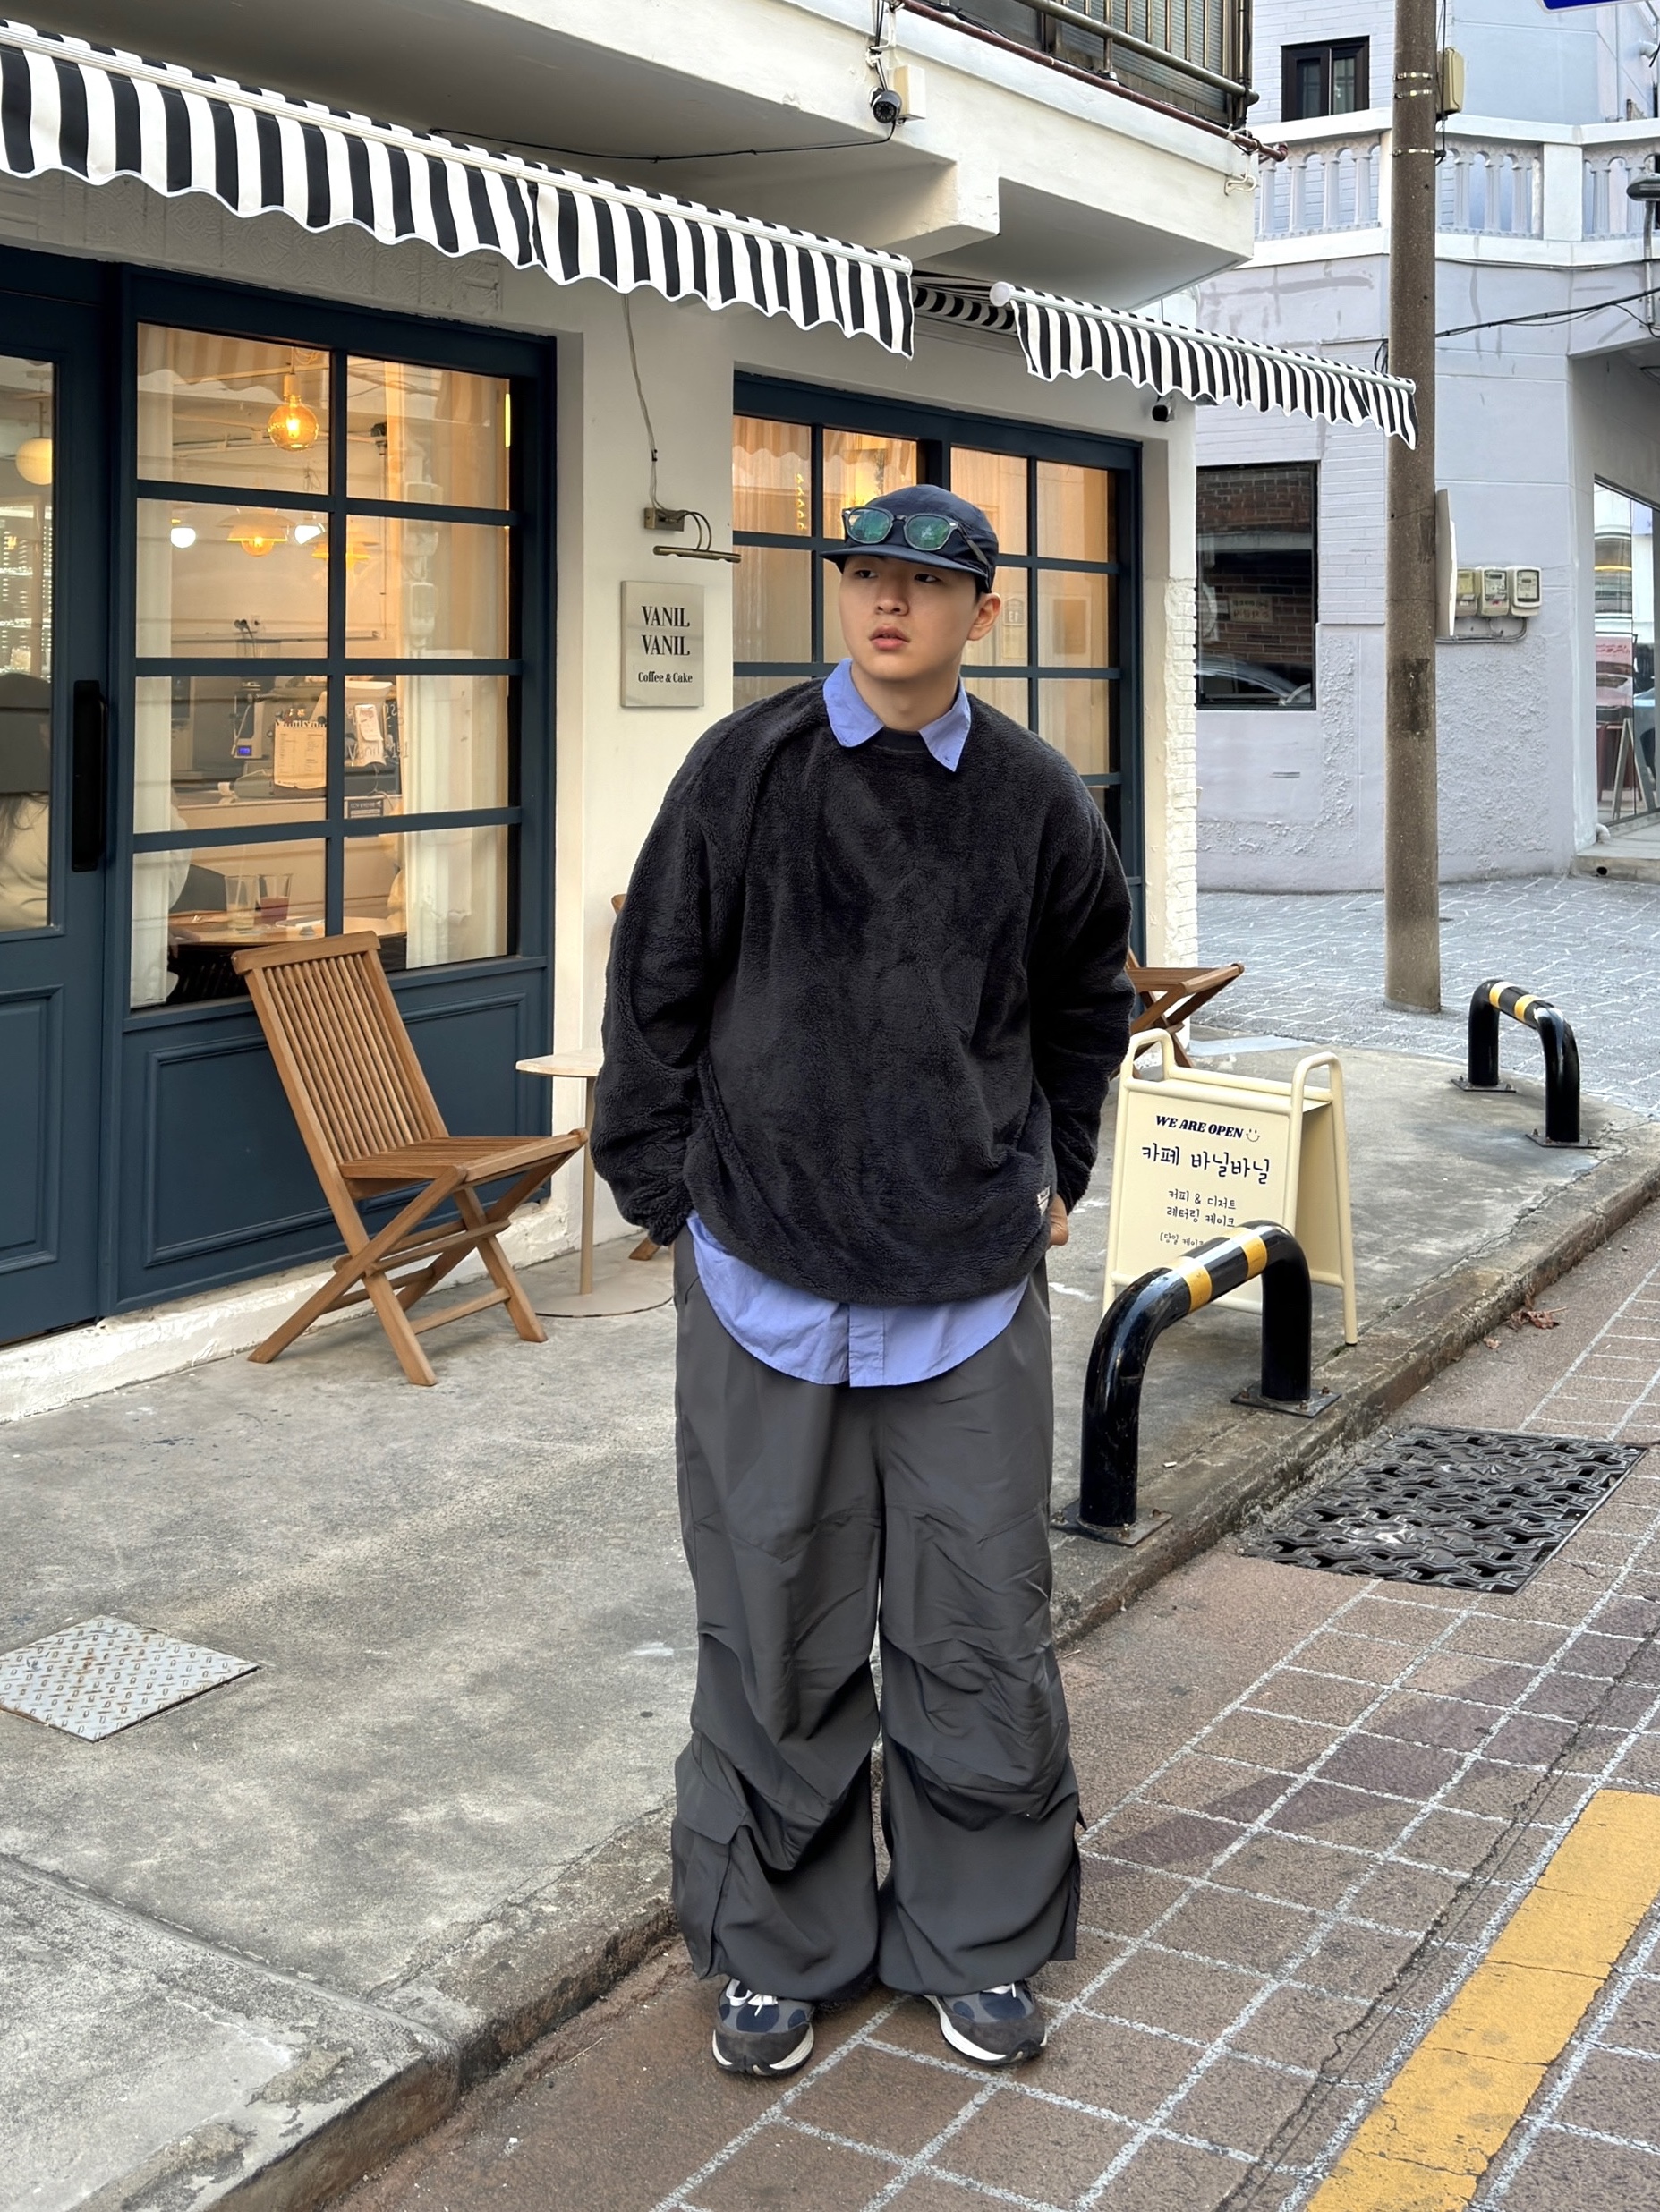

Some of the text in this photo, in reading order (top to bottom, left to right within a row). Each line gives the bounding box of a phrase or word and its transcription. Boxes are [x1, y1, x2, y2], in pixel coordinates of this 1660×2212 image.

[641, 606, 690, 627] VANIL
[641, 634, 691, 656] VANIL
[638, 671, 693, 683] Coffee & Cake
[1156, 1115, 1244, 1139] WE ARE OPEN
[1142, 1143, 1270, 1185] 카페 바닐바닐
[1169, 1188, 1237, 1210] 커피 & 디저트
[1167, 1206, 1235, 1227] 레터링 케이크
